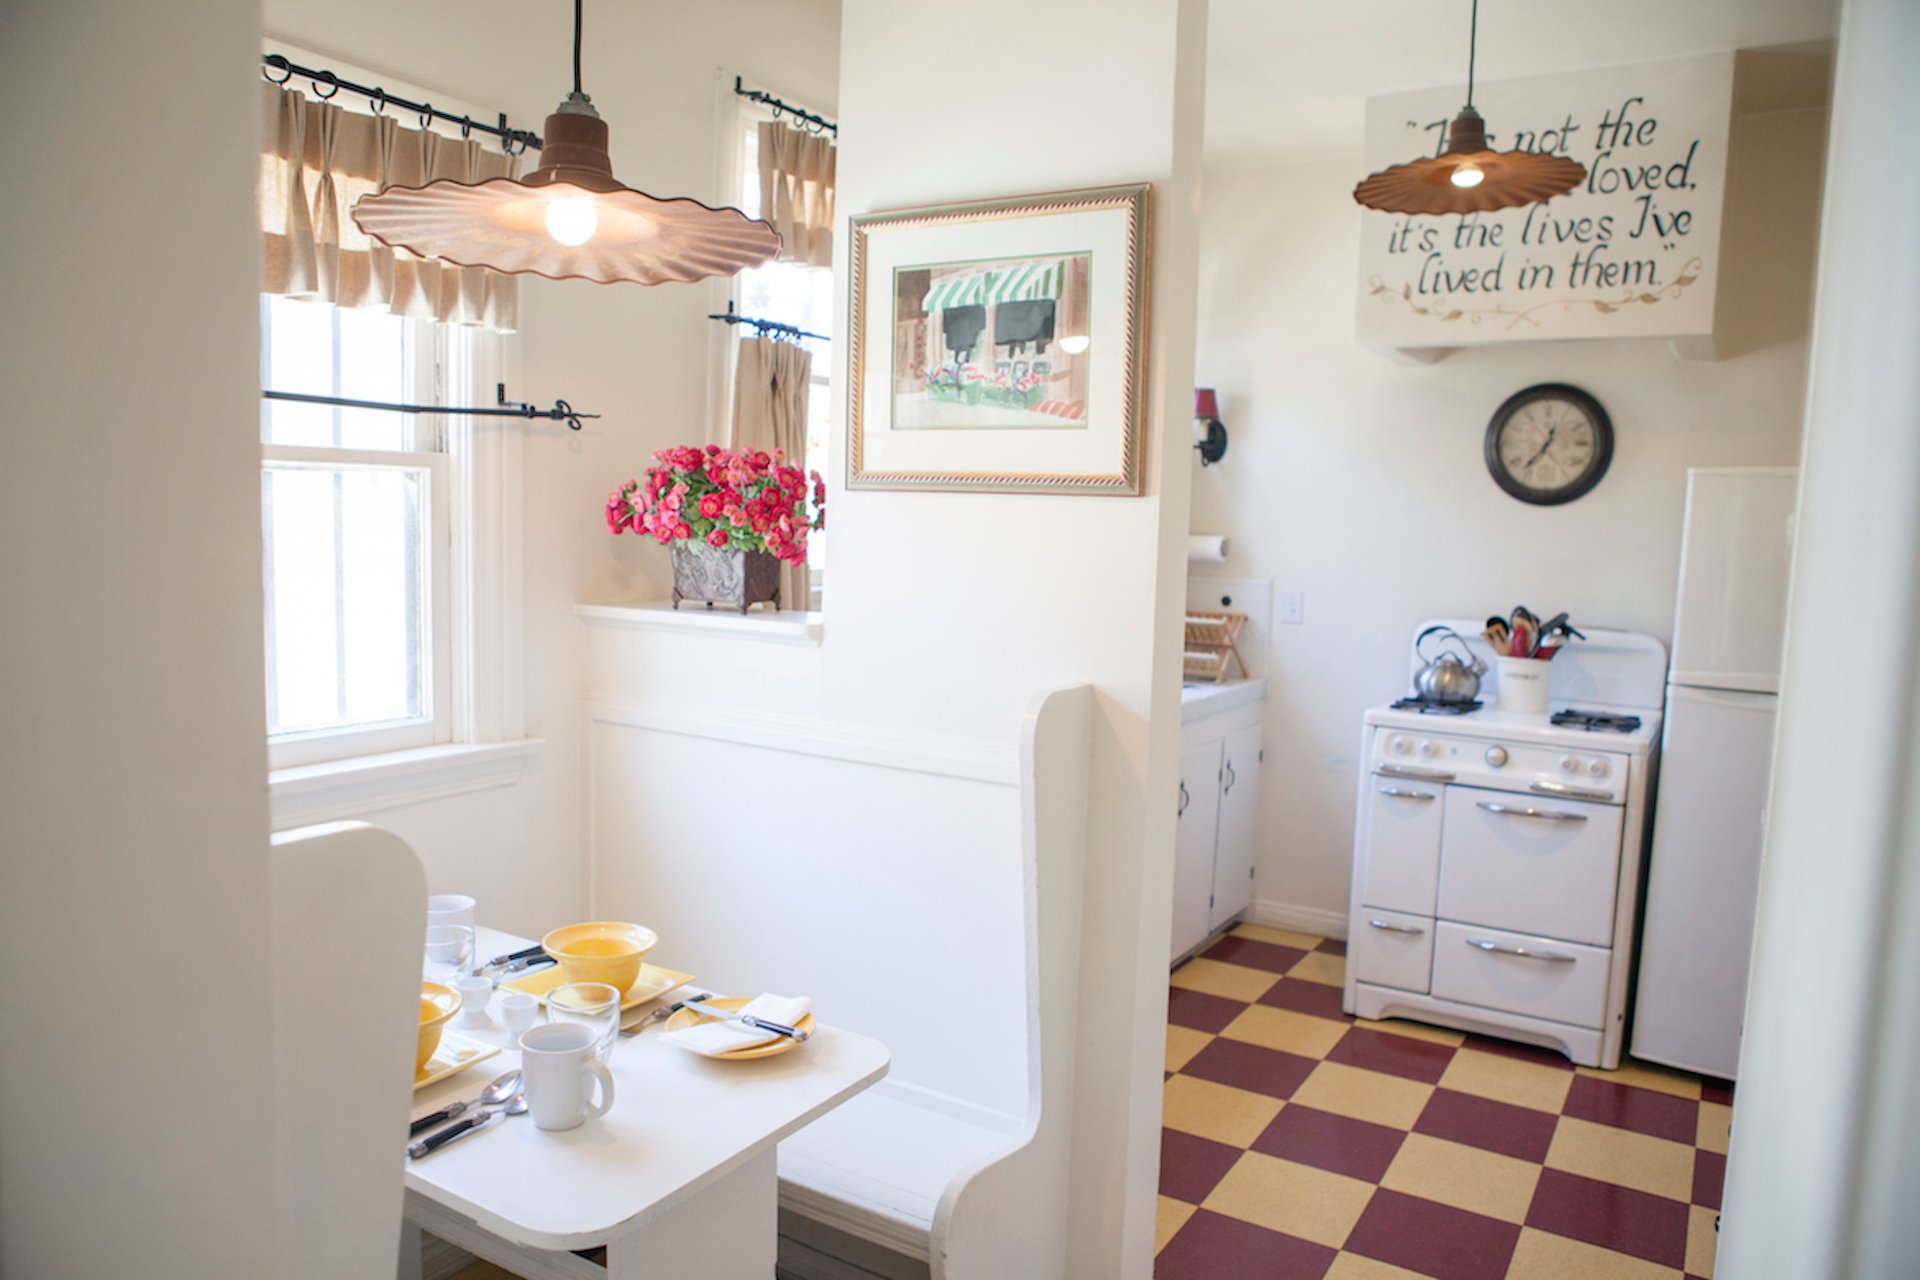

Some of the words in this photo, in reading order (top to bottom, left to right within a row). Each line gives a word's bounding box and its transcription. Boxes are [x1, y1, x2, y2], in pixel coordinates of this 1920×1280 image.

[1514, 114, 1580, 154] not
[1595, 97, 1657, 149] the
[1389, 206, 1438, 253] it's
[1454, 204, 1503, 248] the
[1522, 200, 1614, 244] lives
[1630, 194, 1692, 239] I've
[1419, 250, 1505, 294] lived
[1519, 258, 1553, 290] in
